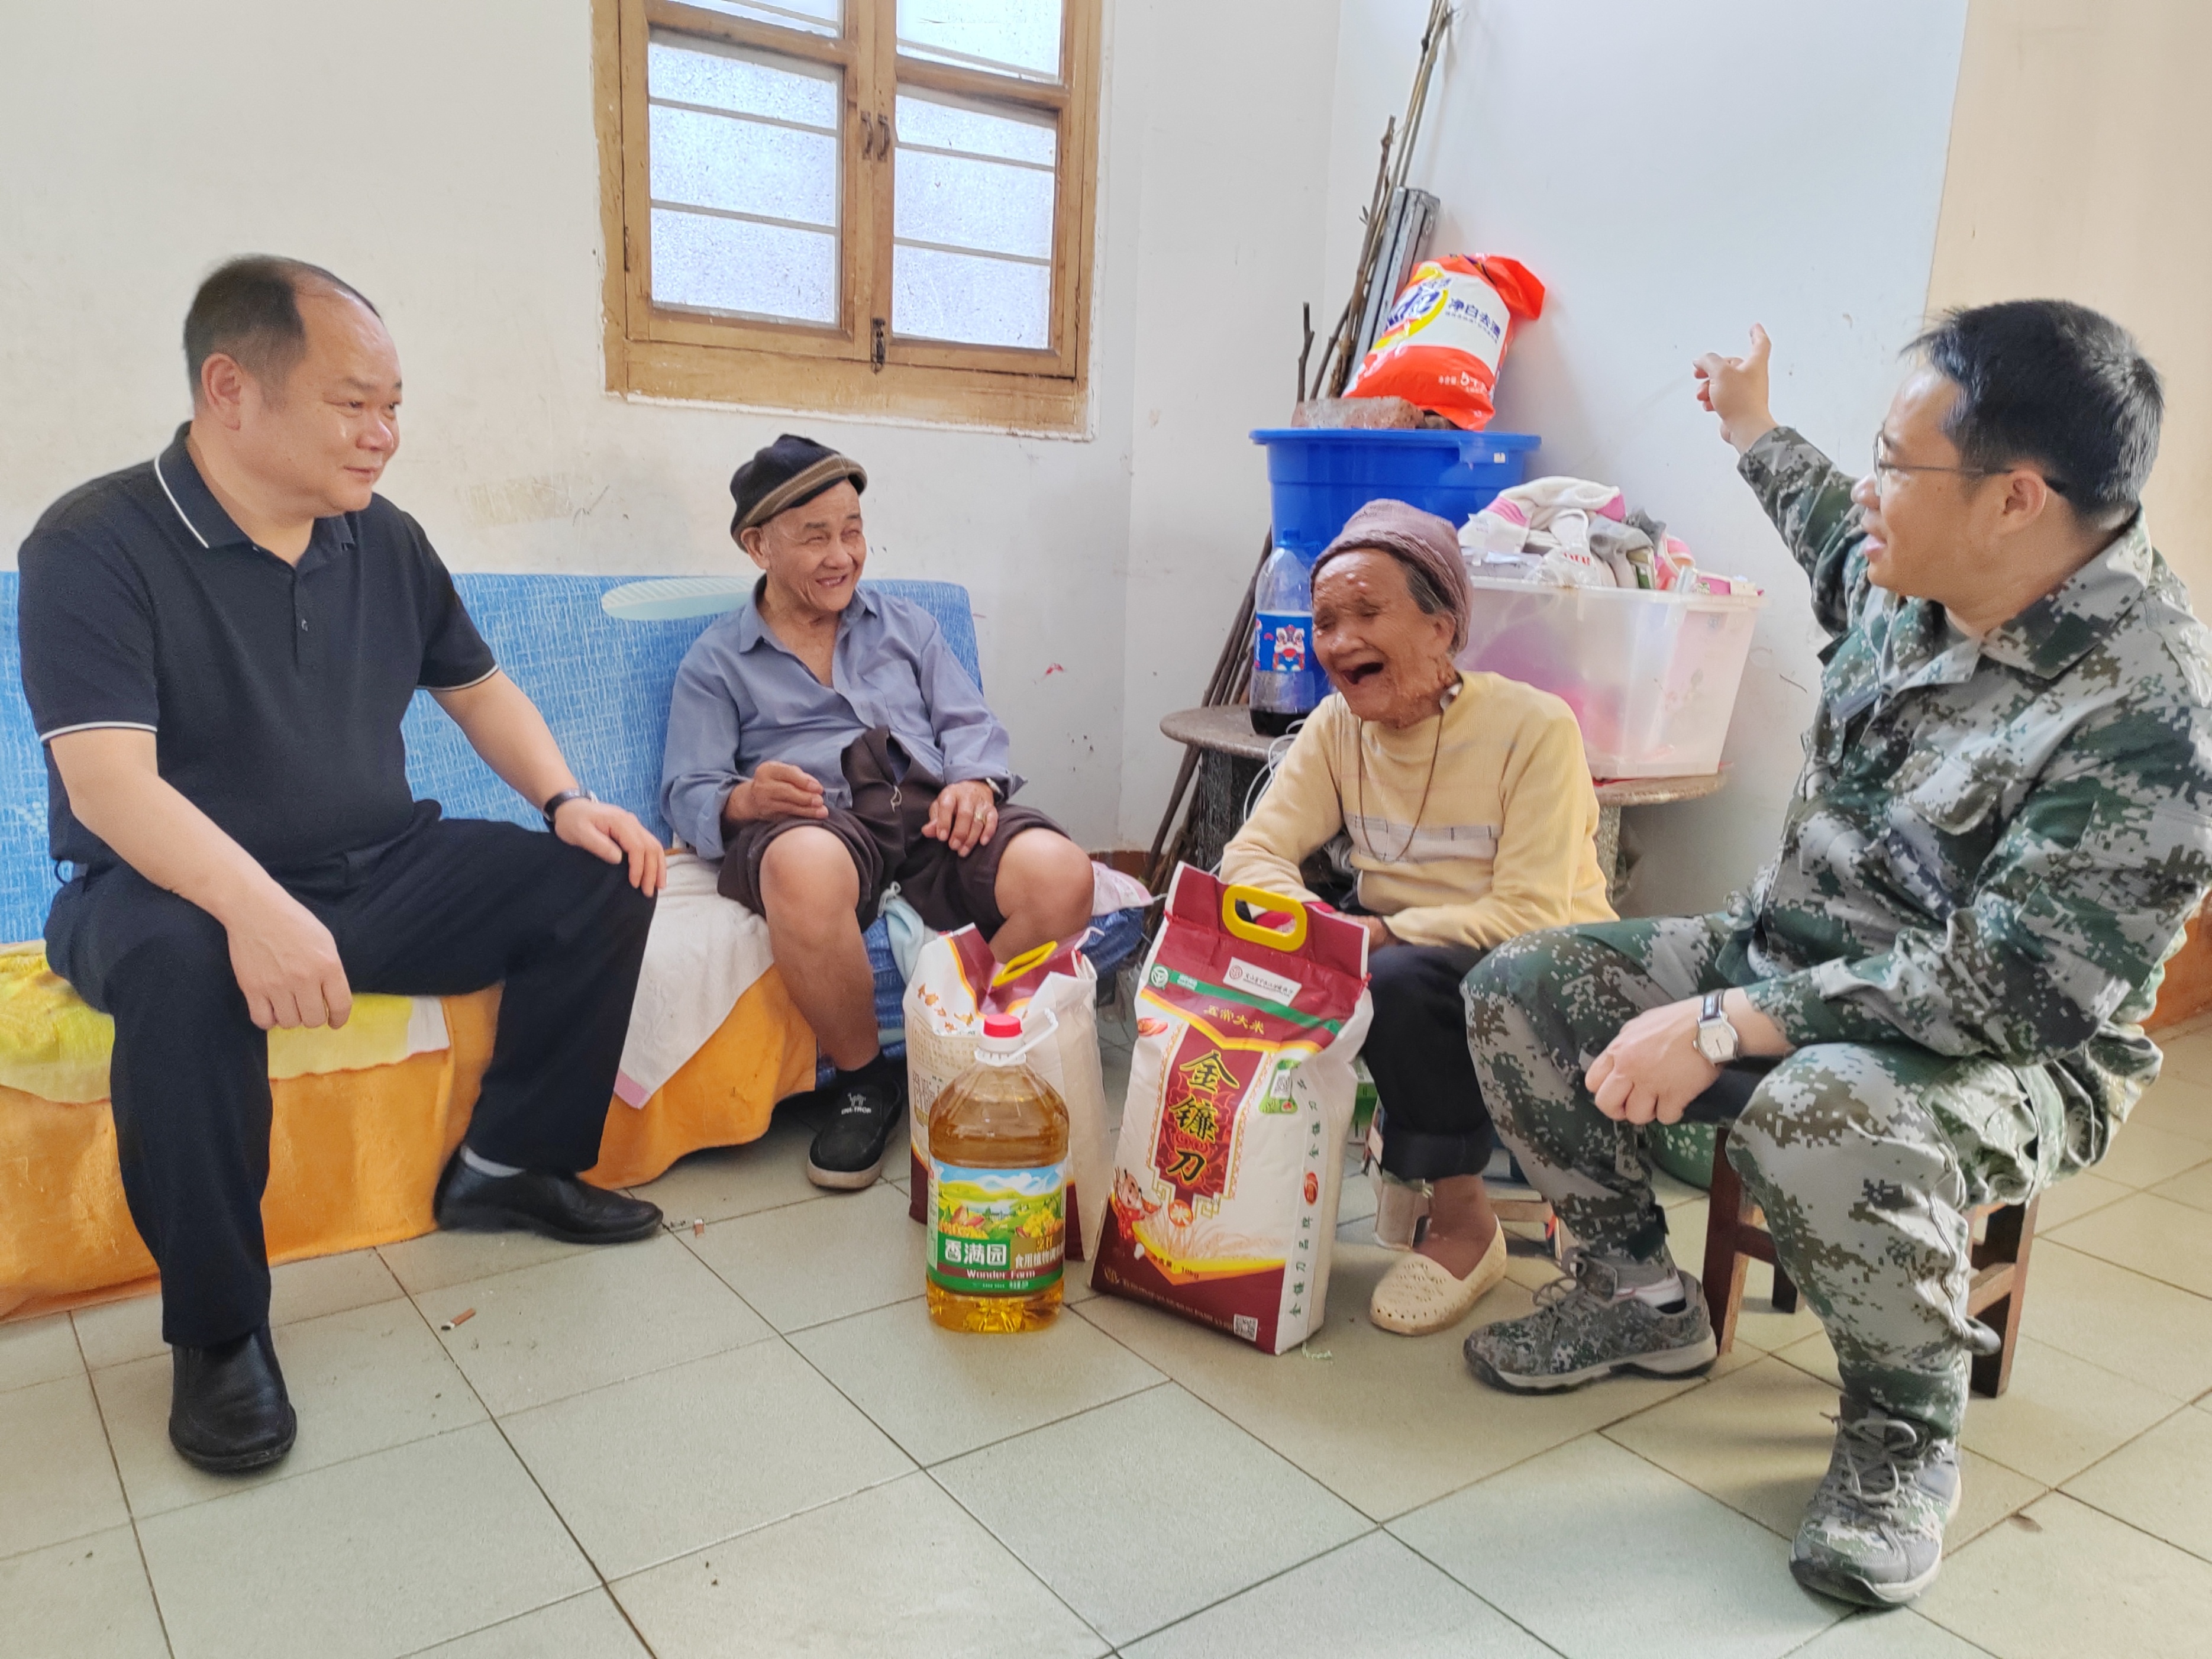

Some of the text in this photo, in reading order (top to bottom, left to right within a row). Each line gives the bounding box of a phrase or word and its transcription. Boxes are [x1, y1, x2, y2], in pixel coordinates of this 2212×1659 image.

[1166, 1048, 1240, 1184] 金镰刀
[945, 1239, 1007, 1266] 香满园
[966, 1269, 1036, 1280] Wonder Farm
